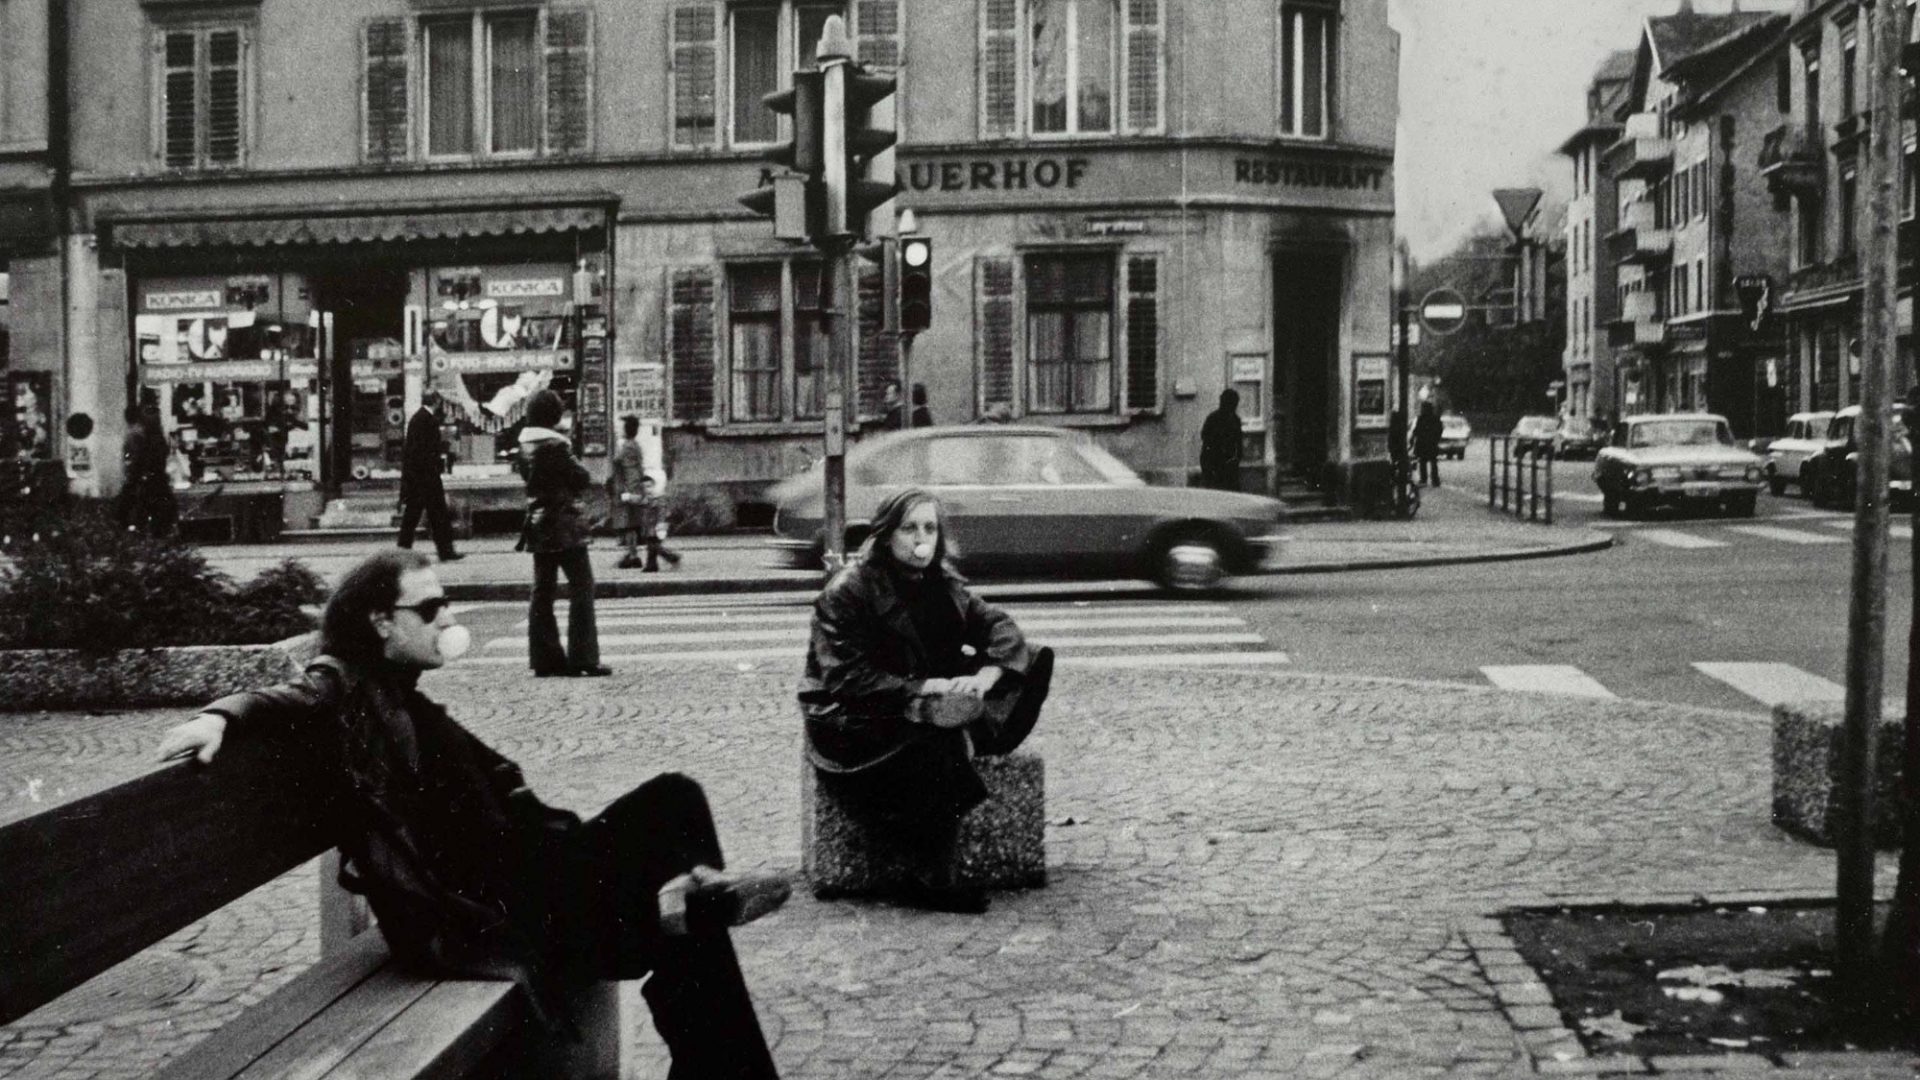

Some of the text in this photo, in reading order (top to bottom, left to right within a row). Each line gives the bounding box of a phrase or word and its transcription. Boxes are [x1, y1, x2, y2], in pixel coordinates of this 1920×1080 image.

[1235, 158, 1384, 191] RESTAURANT
[491, 281, 559, 295] KONICA
[148, 293, 216, 307] KONICA
